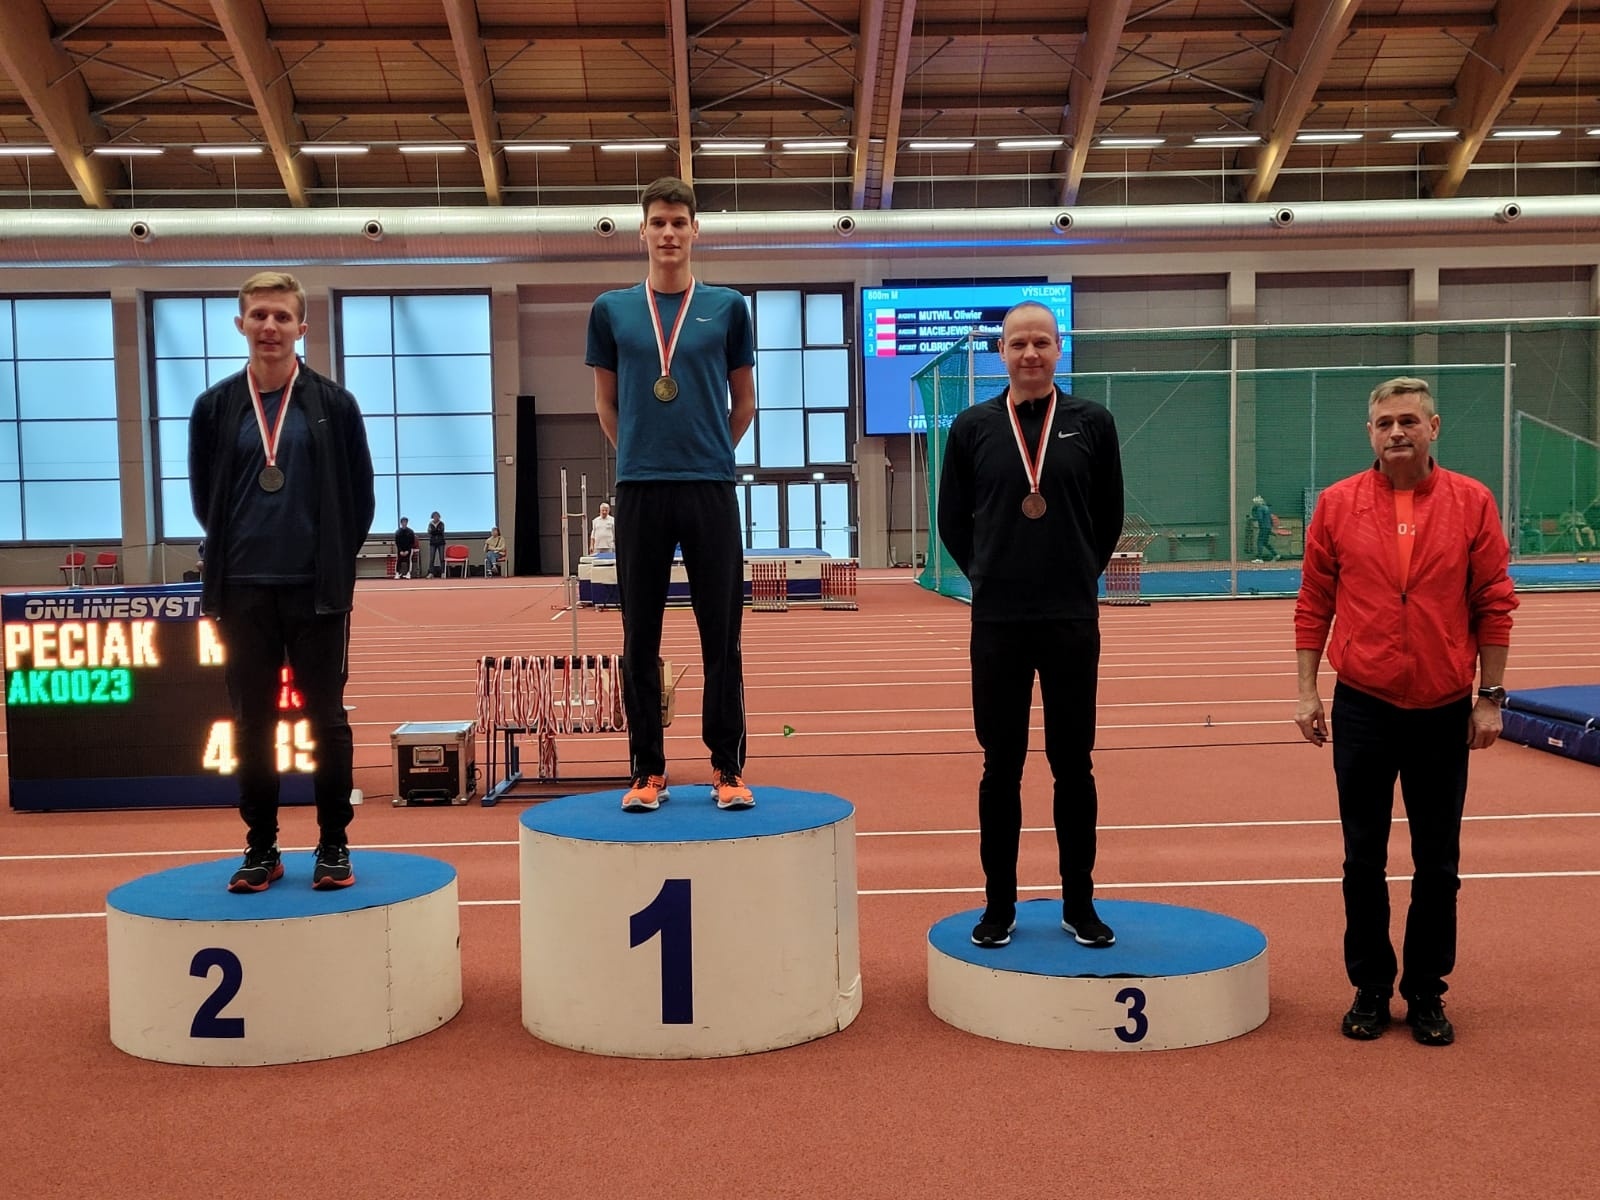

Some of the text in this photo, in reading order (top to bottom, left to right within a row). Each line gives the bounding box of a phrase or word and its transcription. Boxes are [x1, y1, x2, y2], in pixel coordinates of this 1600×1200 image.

[1021, 286, 1067, 297] VÝSLEDKY
[918, 310, 953, 320] MUTWIL
[953, 309, 983, 320] Oliwier
[24, 596, 204, 620] ONLINESYST
[4, 620, 160, 668] PECIAK
[7, 669, 132, 705] AK0023
[629, 879, 694, 1024] 1
[189, 947, 246, 1039] 2
[1113, 987, 1149, 1043] 3
